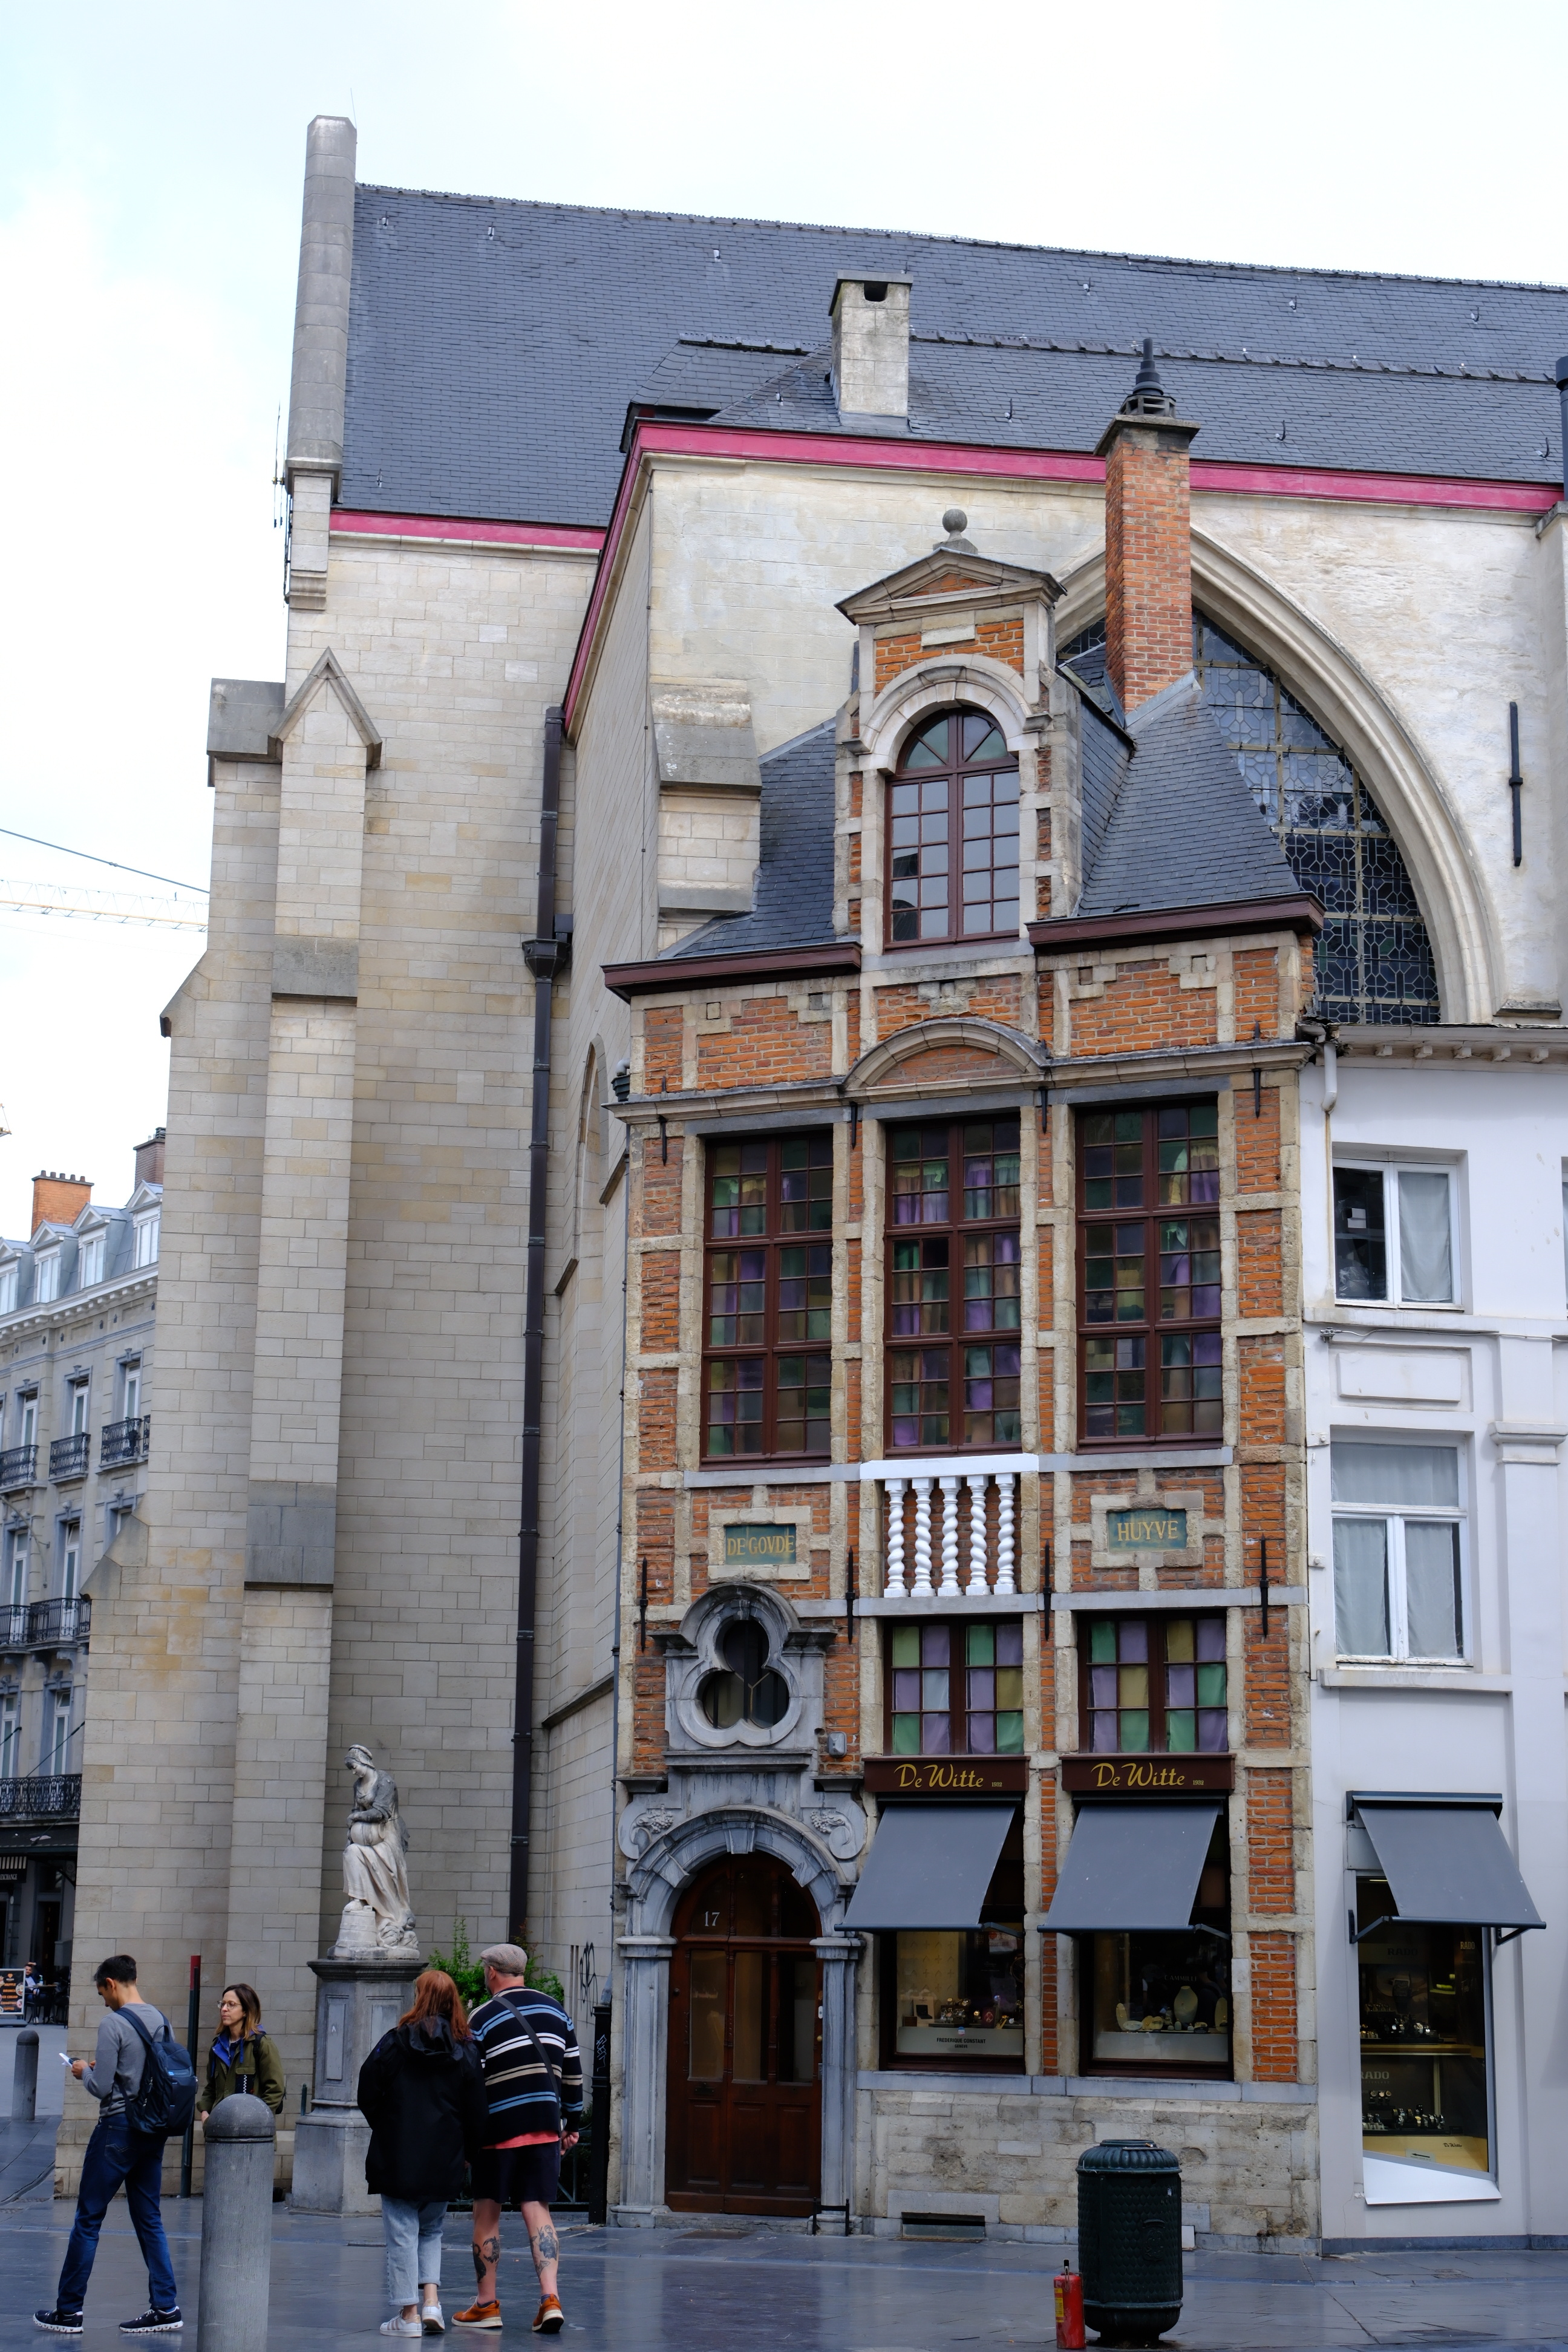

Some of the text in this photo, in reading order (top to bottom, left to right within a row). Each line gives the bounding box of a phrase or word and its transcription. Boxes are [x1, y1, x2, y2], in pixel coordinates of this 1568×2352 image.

[1117, 1520, 1178, 1541] HUYVE
[727, 1538, 746, 1555] DE
[893, 1763, 923, 1788] De
[923, 1763, 984, 1788] Witte
[1091, 1763, 1120, 1787] De
[1121, 1762, 1185, 1786] Witte
[704, 1911, 720, 1927] 17
